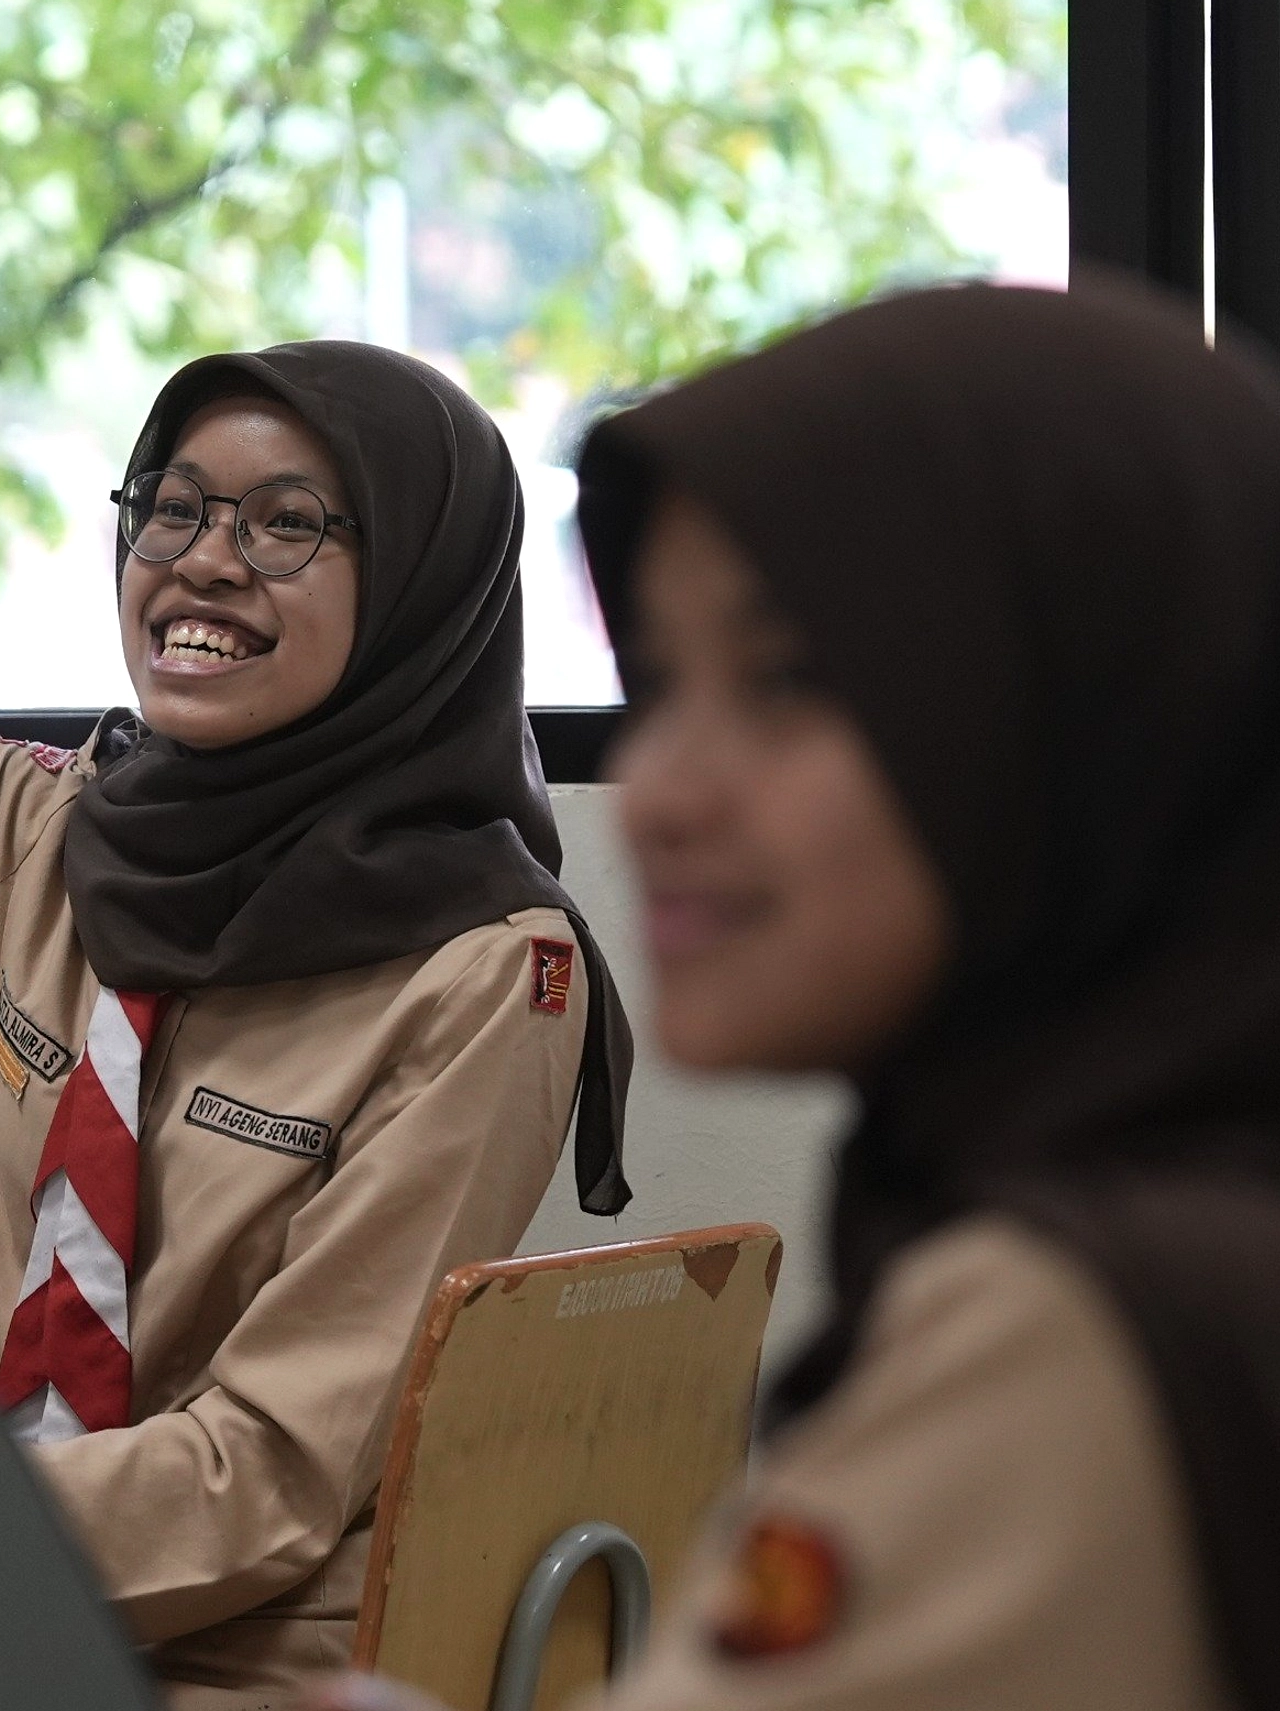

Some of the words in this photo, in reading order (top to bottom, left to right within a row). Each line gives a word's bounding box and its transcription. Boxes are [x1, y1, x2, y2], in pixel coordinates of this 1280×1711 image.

[7, 1016, 46, 1062] ALMIRA
[43, 1050, 59, 1070] S
[194, 1095, 222, 1121] NYI
[219, 1106, 268, 1138] AGENG
[264, 1120, 322, 1150] SERANG
